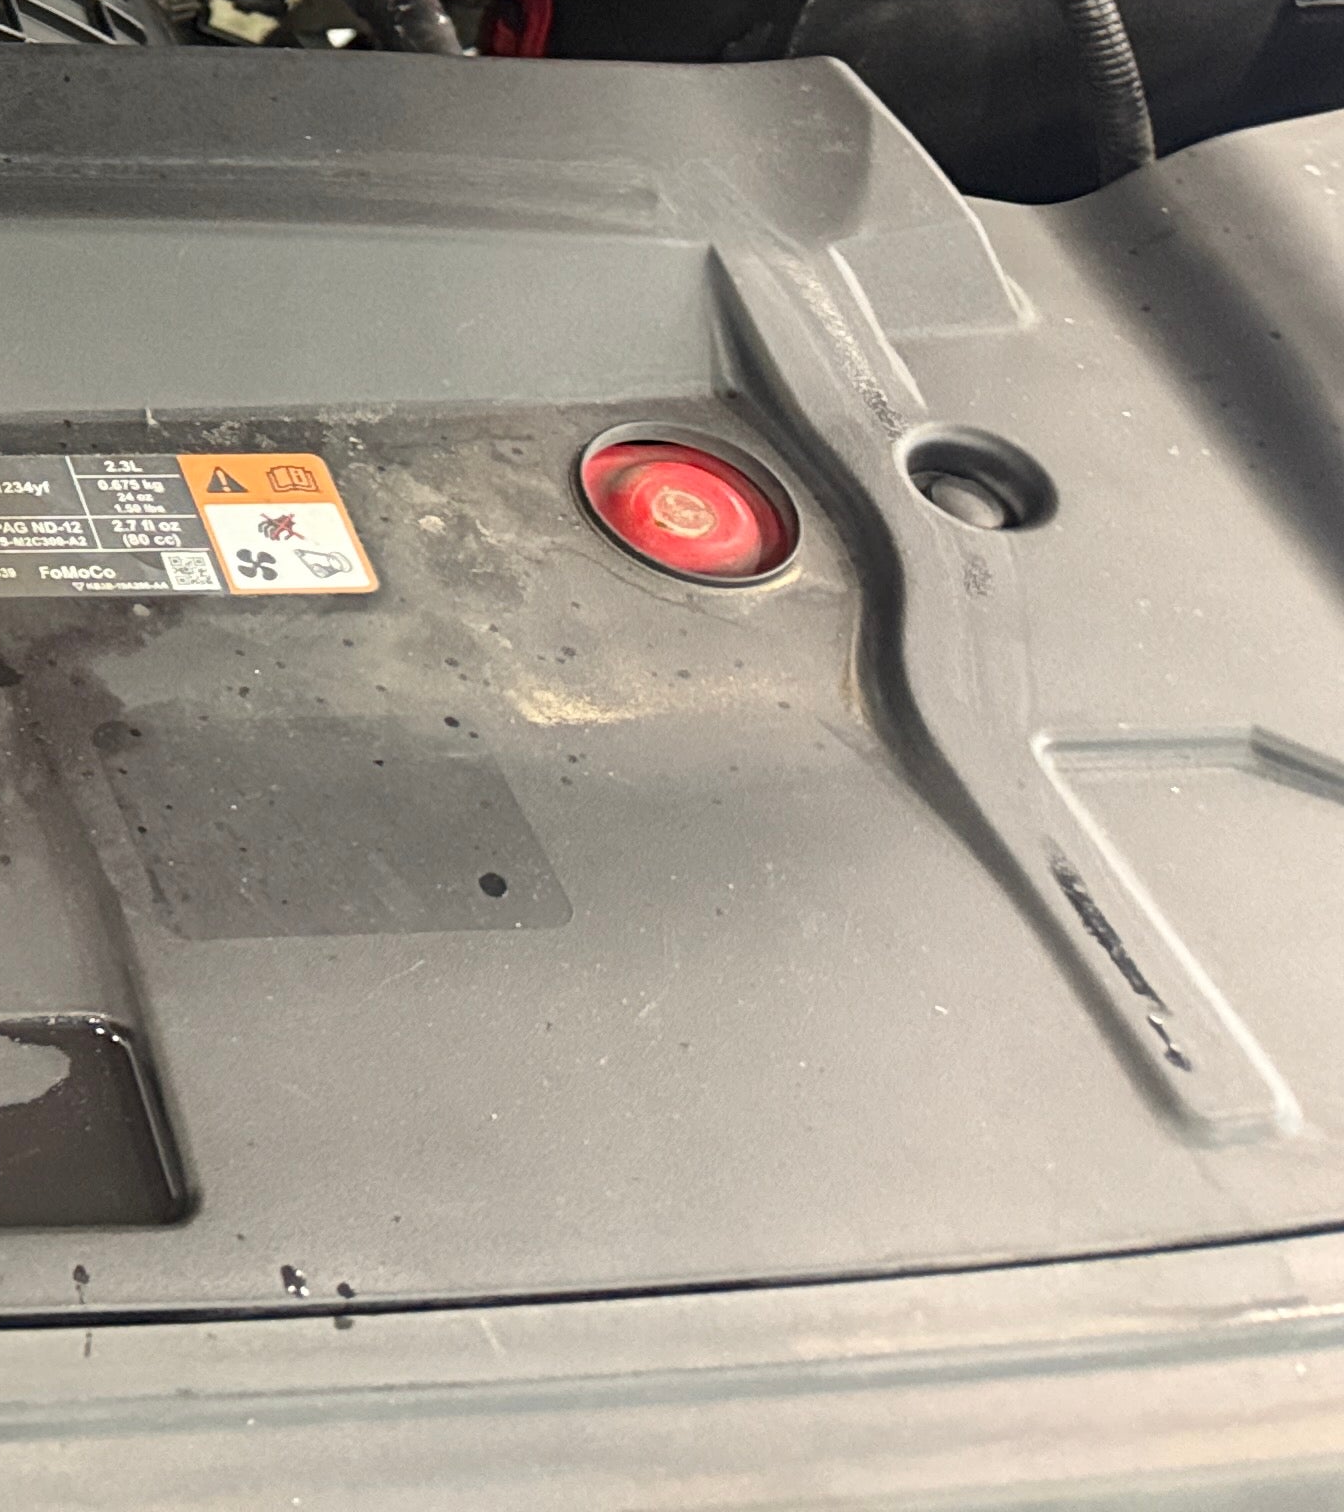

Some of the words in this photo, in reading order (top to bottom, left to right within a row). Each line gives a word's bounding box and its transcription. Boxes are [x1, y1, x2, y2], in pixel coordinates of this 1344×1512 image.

[103, 460, 144, 473] 2.3L
[141, 479, 165, 494] kg
[116, 492, 135, 503] 24
[136, 494, 154, 502] oz
[30, 521, 83, 534] ND-12
[111, 519, 137, 533] 2.7
[158, 522, 182, 533] oz
[122, 533, 151, 548] (80
[153, 533, 182, 548] cc)
[38, 565, 116, 580] FoMoCo
